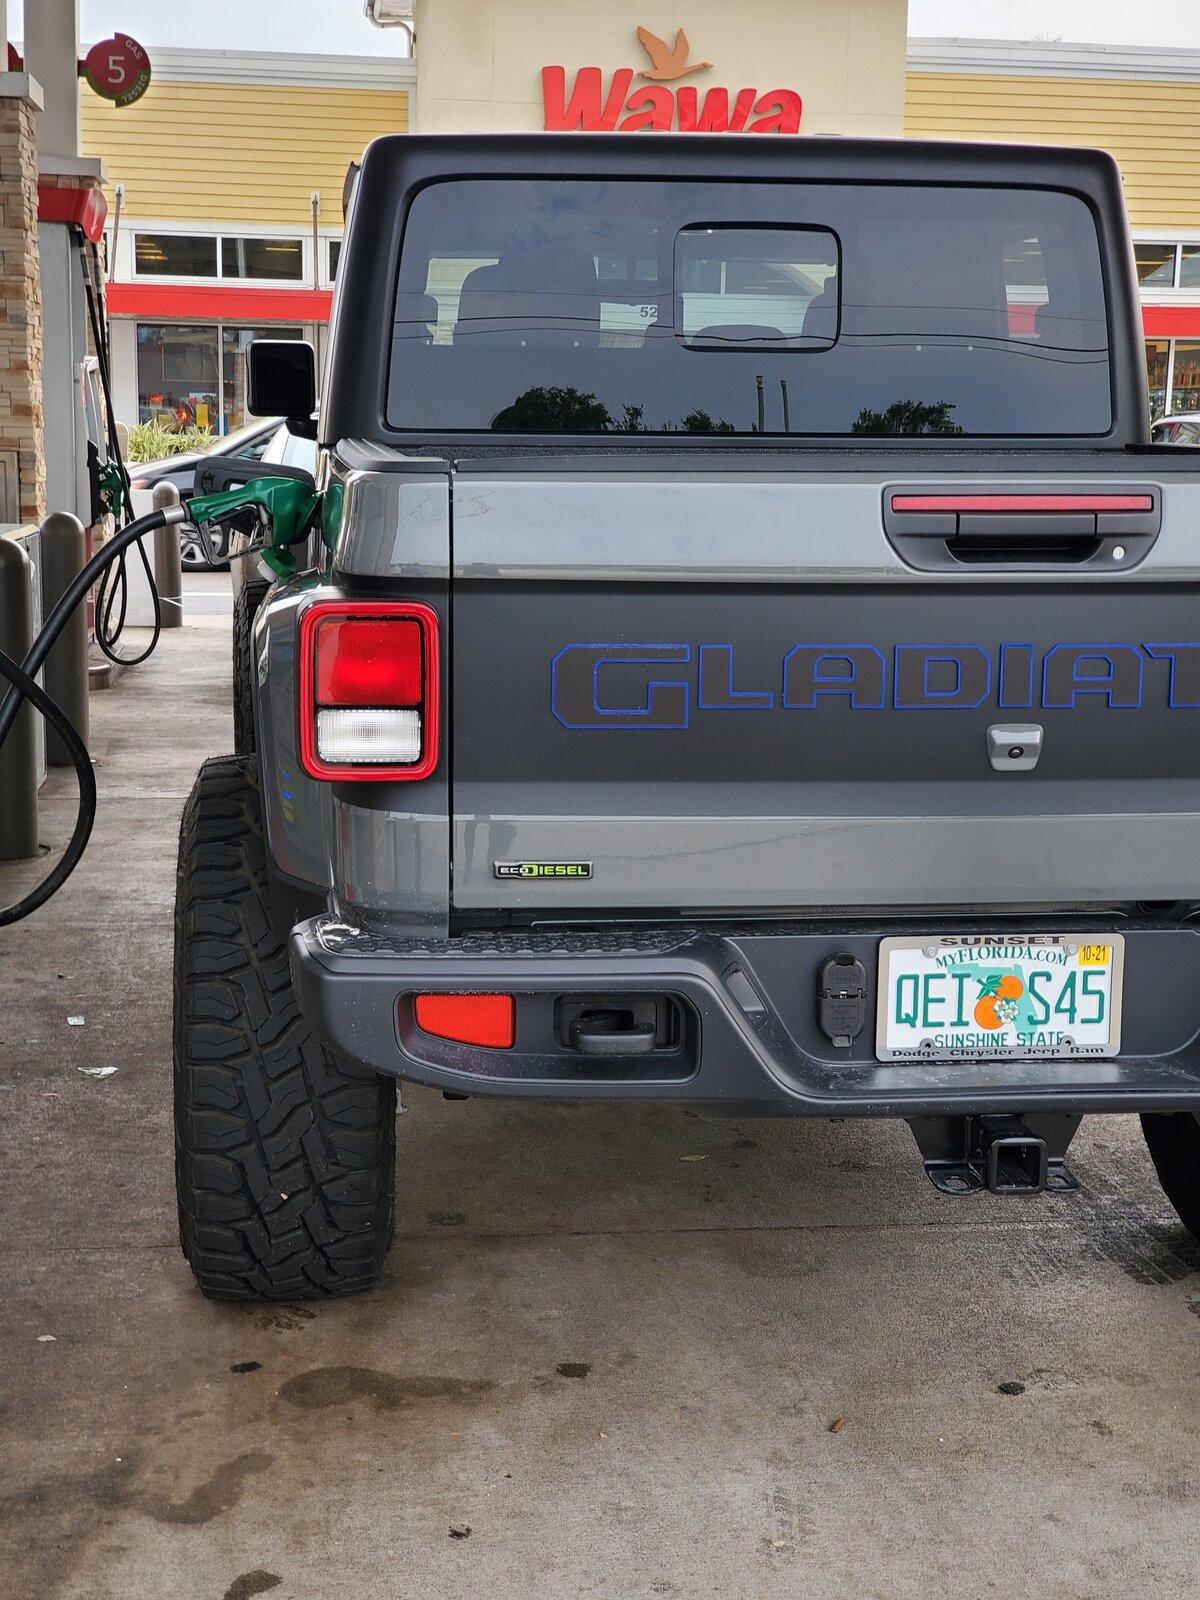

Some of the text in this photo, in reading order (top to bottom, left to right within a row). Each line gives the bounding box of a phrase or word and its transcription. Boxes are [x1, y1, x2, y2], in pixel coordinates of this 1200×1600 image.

[125, 39, 143, 60] GAS
[107, 55, 126, 84] 5
[121, 73, 148, 103] DIESEL
[541, 65, 802, 134] Wawa
[940, 936, 1066, 945] SUNSET
[1082, 945, 1107, 962] 10-21
[896, 970, 1106, 1028] QEI S45
[934, 1031, 1064, 1048] SUNSHINE STATE
[892, 1050, 940, 1058] Dodge
[950, 1049, 1015, 1057] Chrysler
[1023, 1048, 1060, 1056] Jeep
